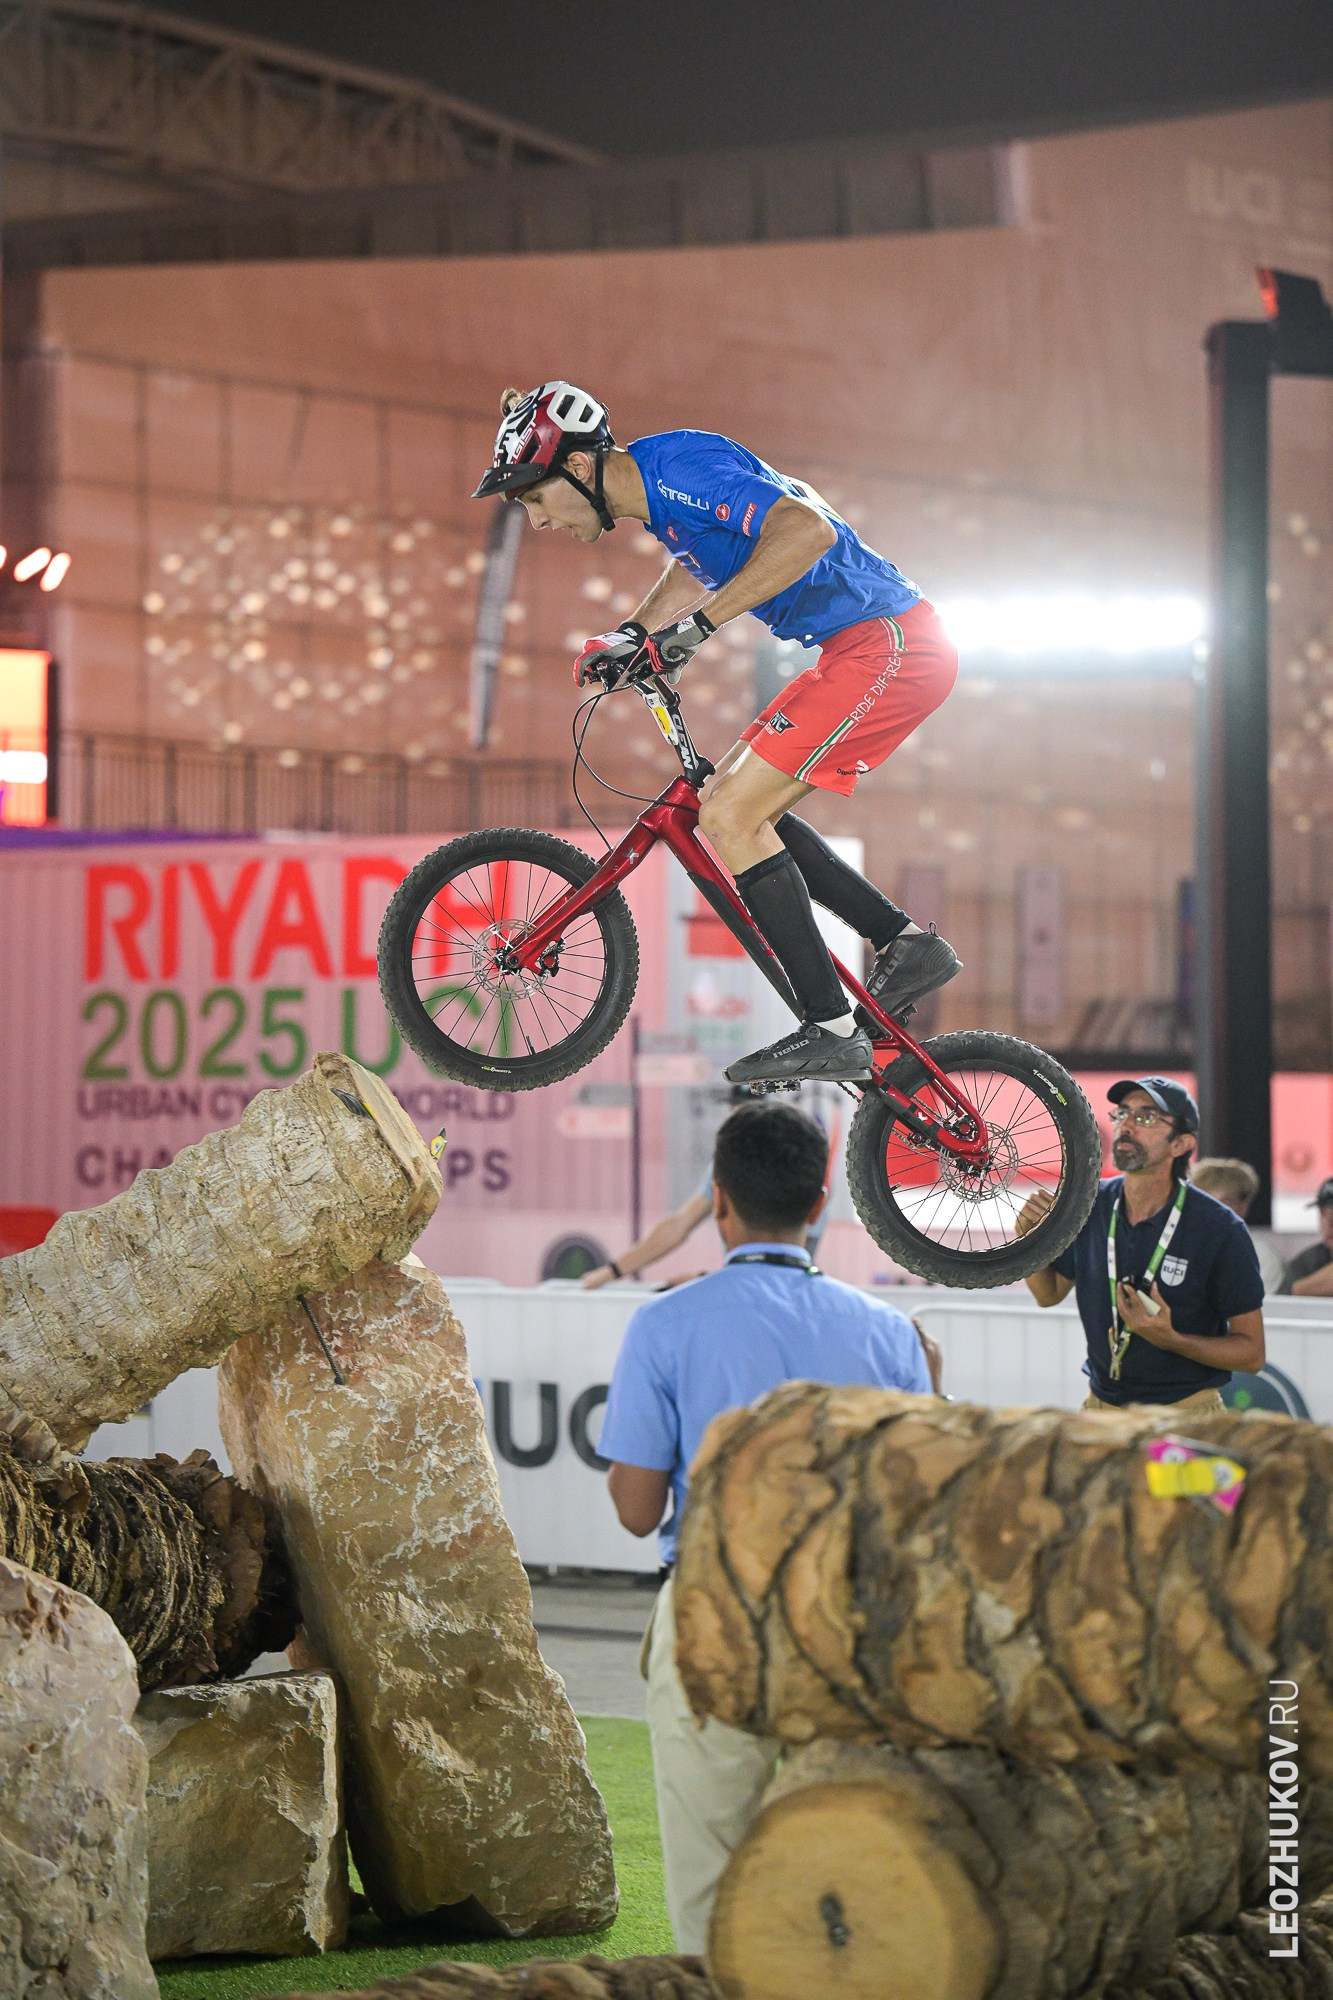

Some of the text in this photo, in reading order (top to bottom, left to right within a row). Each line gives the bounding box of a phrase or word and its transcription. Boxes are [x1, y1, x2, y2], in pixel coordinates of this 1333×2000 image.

[512, 420, 537, 458] GIST
[850, 693, 876, 722] RIDE
[84, 858, 513, 983] RIYADH
[82, 987, 309, 1081] 2025
[772, 1039, 810, 1059] hebo
[491, 1380, 613, 1472] UC
